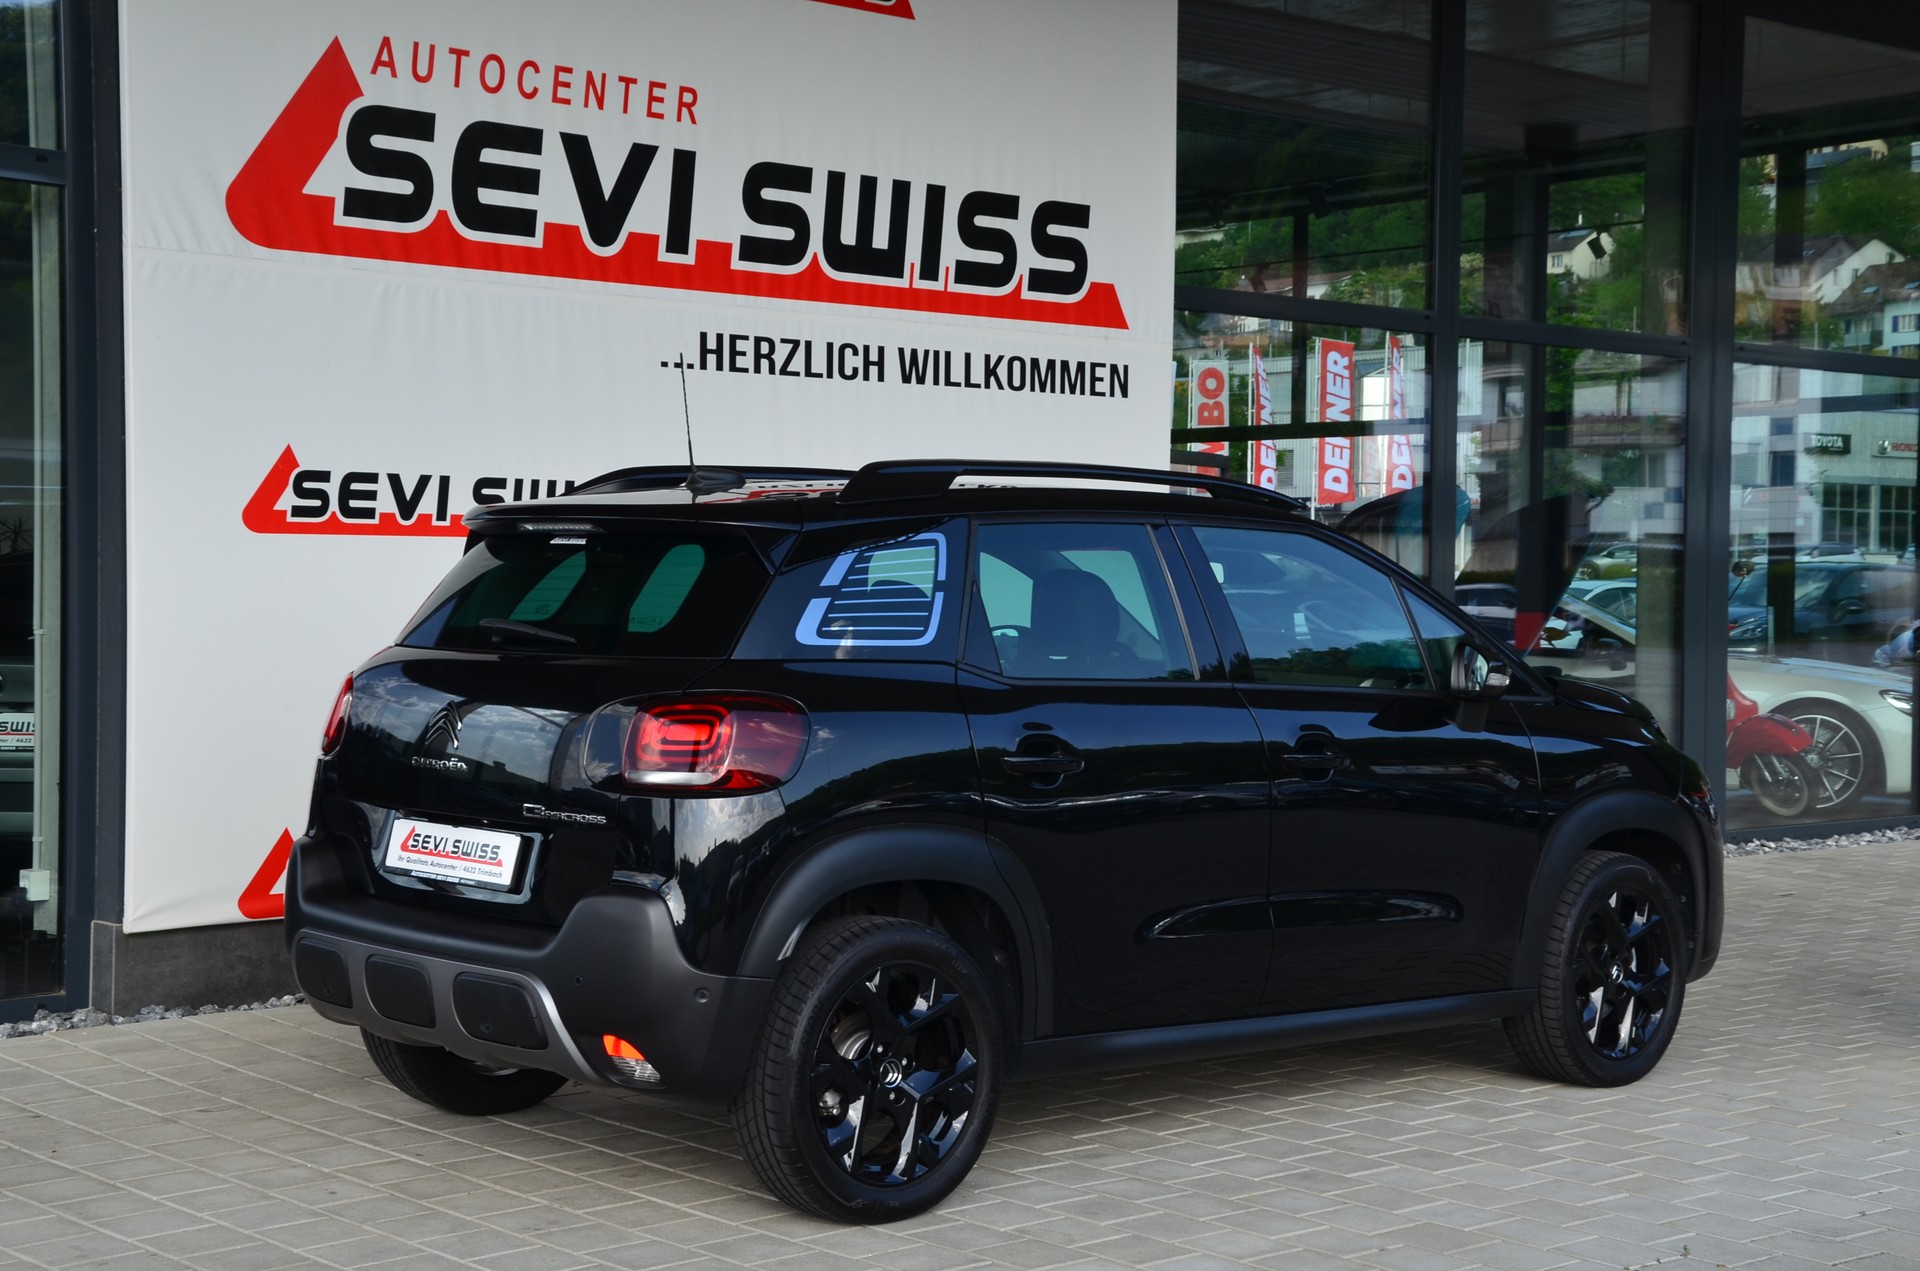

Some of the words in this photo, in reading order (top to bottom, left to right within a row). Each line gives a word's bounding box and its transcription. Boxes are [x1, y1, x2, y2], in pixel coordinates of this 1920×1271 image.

[370, 36, 699, 125] AUTOCENTER
[343, 104, 697, 256] SEVI
[737, 161, 1091, 296] SWISS
[897, 347, 1129, 399] WILLKOMMEN
[1811, 435, 1844, 448] TOYOTA
[291, 469, 451, 522] SEVI
[411, 833, 449, 853] SEVI
[451, 839, 501, 861] SWISS
[430, 860, 457, 870] Autocenter
